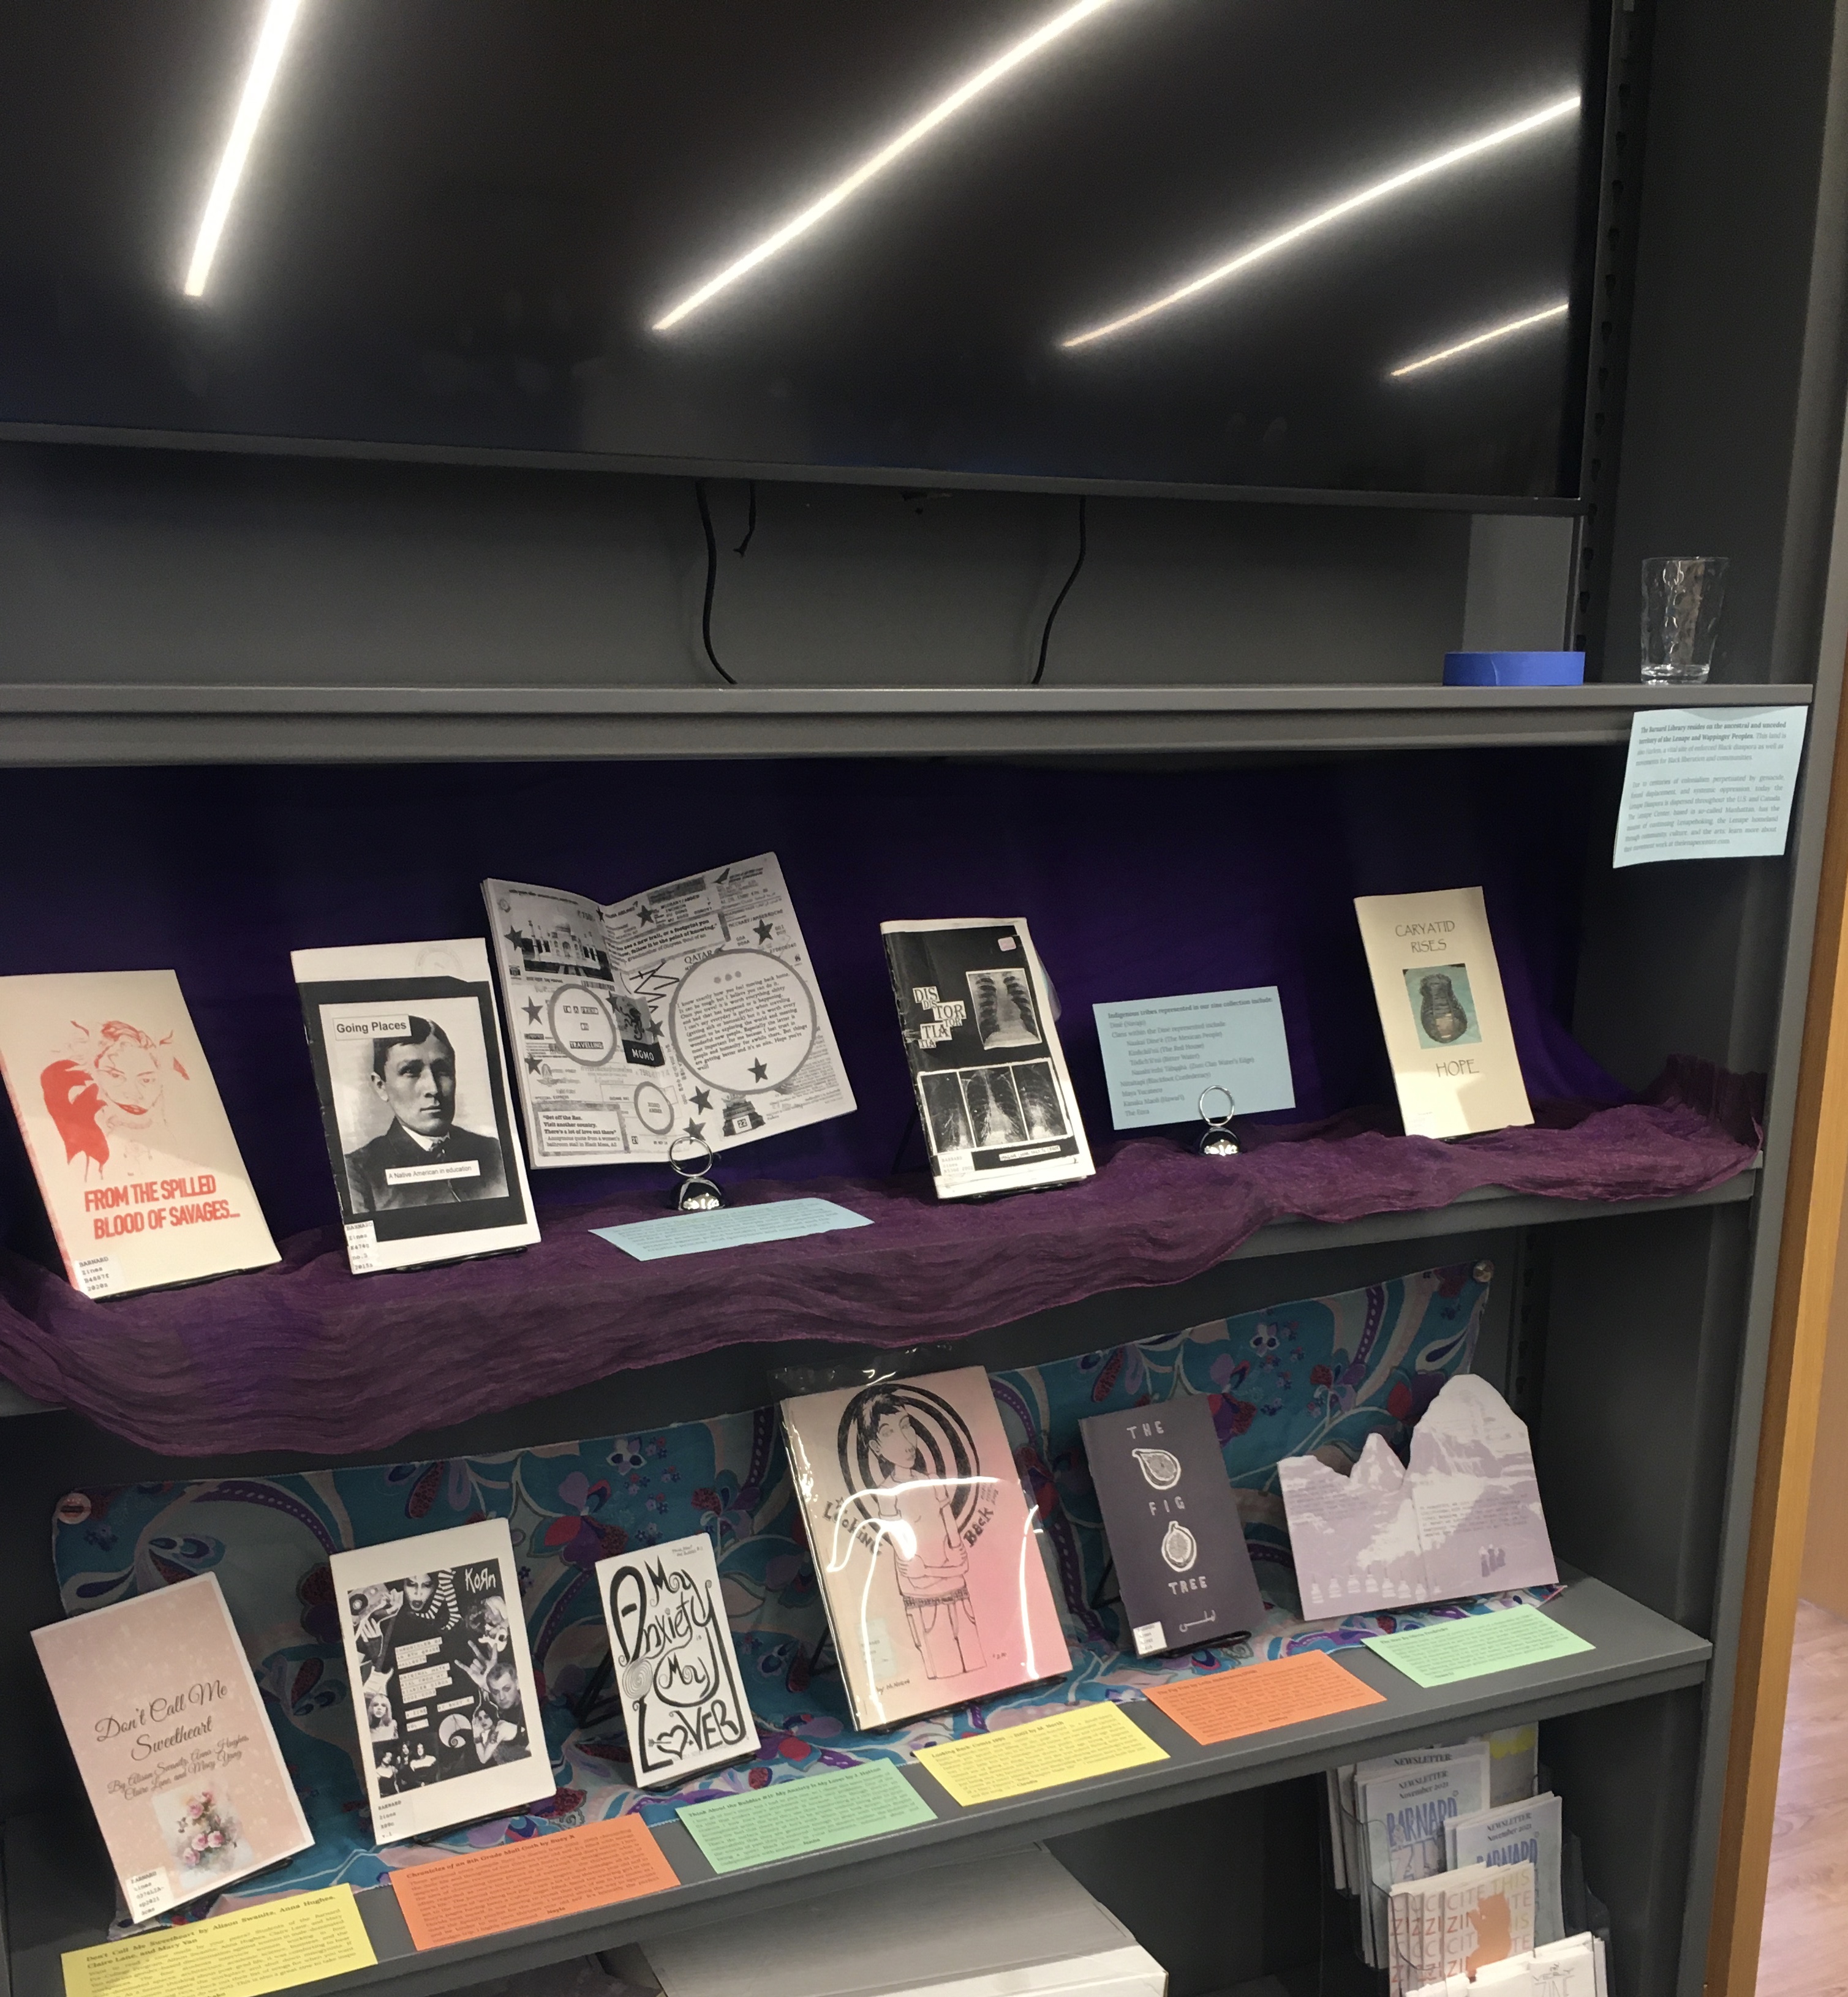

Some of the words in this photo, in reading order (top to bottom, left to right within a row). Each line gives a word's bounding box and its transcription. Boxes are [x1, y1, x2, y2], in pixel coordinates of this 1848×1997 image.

[1667, 724, 1685, 733] Library
[1672, 735, 1691, 743] Lenape
[1395, 920, 1455, 937] CARYATID
[1410, 939, 1447, 953] RISES
[684, 950, 712, 964] QATAR
[914, 987, 938, 1002] DIS
[923, 1000, 937, 1009] DIS
[937, 1004, 966, 1019] TOR
[1108, 1009, 1139, 1020] Indigenous
[1158, 1004, 1191, 1015] represented
[1223, 999, 1251, 1008] collection
[337, 1023, 369, 1034] Going
[371, 1021, 407, 1031] Places
[921, 1024, 950, 1039] TIA
[943, 1018, 962, 1028] TOR
[1172, 1023, 1204, 1034] represented
[920, 1039, 936, 1048] TIA
[1436, 1059, 1480, 1077] HOPE
[738, 1119, 748, 1127] 22
[85, 1185, 129, 1212] FROM
[130, 1181, 159, 1204] THE
[160, 1175, 216, 1200] SPILLED
[94, 1211, 145, 1239] BLOOD
[148, 1208, 167, 1230] OF
[79, 1257, 109, 1267] BARNARD
[1126, 1421, 1164, 1439] THE
[1148, 1496, 1186, 1516] FIG
[1168, 1576, 1207, 1595] TREE
[94, 1708, 146, 1742] Don't
[149, 1694, 185, 1723] Call
[188, 1680, 228, 1706] Me
[130, 1715, 213, 1761] Sweetheart
[107, 1780, 126, 1794] By
[127, 1772, 153, 1786] Alison
[190, 1749, 212, 1762] Anna
[1398, 1770, 1449, 1789] NEWSLETTER
[124, 1787, 149, 1800] Claire
[173, 1770, 187, 1781] and
[1400, 1786, 1433, 1799] November
[1434, 1781, 1449, 1791] 2021
[378, 1800, 401, 1811] BARNARD
[708, 1805, 726, 1814] About
[737, 1797, 761, 1807] Bubbles
[1387, 1797, 1458, 1848] BARNARD
[1487, 1812, 1531, 1832] NEWSLETTER
[1488, 1829, 1518, 1841] November
[406, 1866, 445, 1879] Chronicles
[480, 1851, 502, 1862] Grade
[503, 1847, 520, 1856] Mall
[1446, 1884, 1485, 1911] CITE
[1492, 1869, 1530, 1895] THIS
[86, 1951, 108, 1962] Don't
[112, 1947, 129, 1955] Call
[149, 1930, 195, 1946] Sweetheart
[213, 1920, 239, 1930] Alison
[279, 1904, 301, 1913] Anna
[303, 1895, 336, 1906] Hughes,
[87, 1960, 114, 1969] Claire
[115, 1953, 138, 1964] Lane,
[140, 1947, 156, 1957] and
[157, 1942, 180, 1952] Mary
